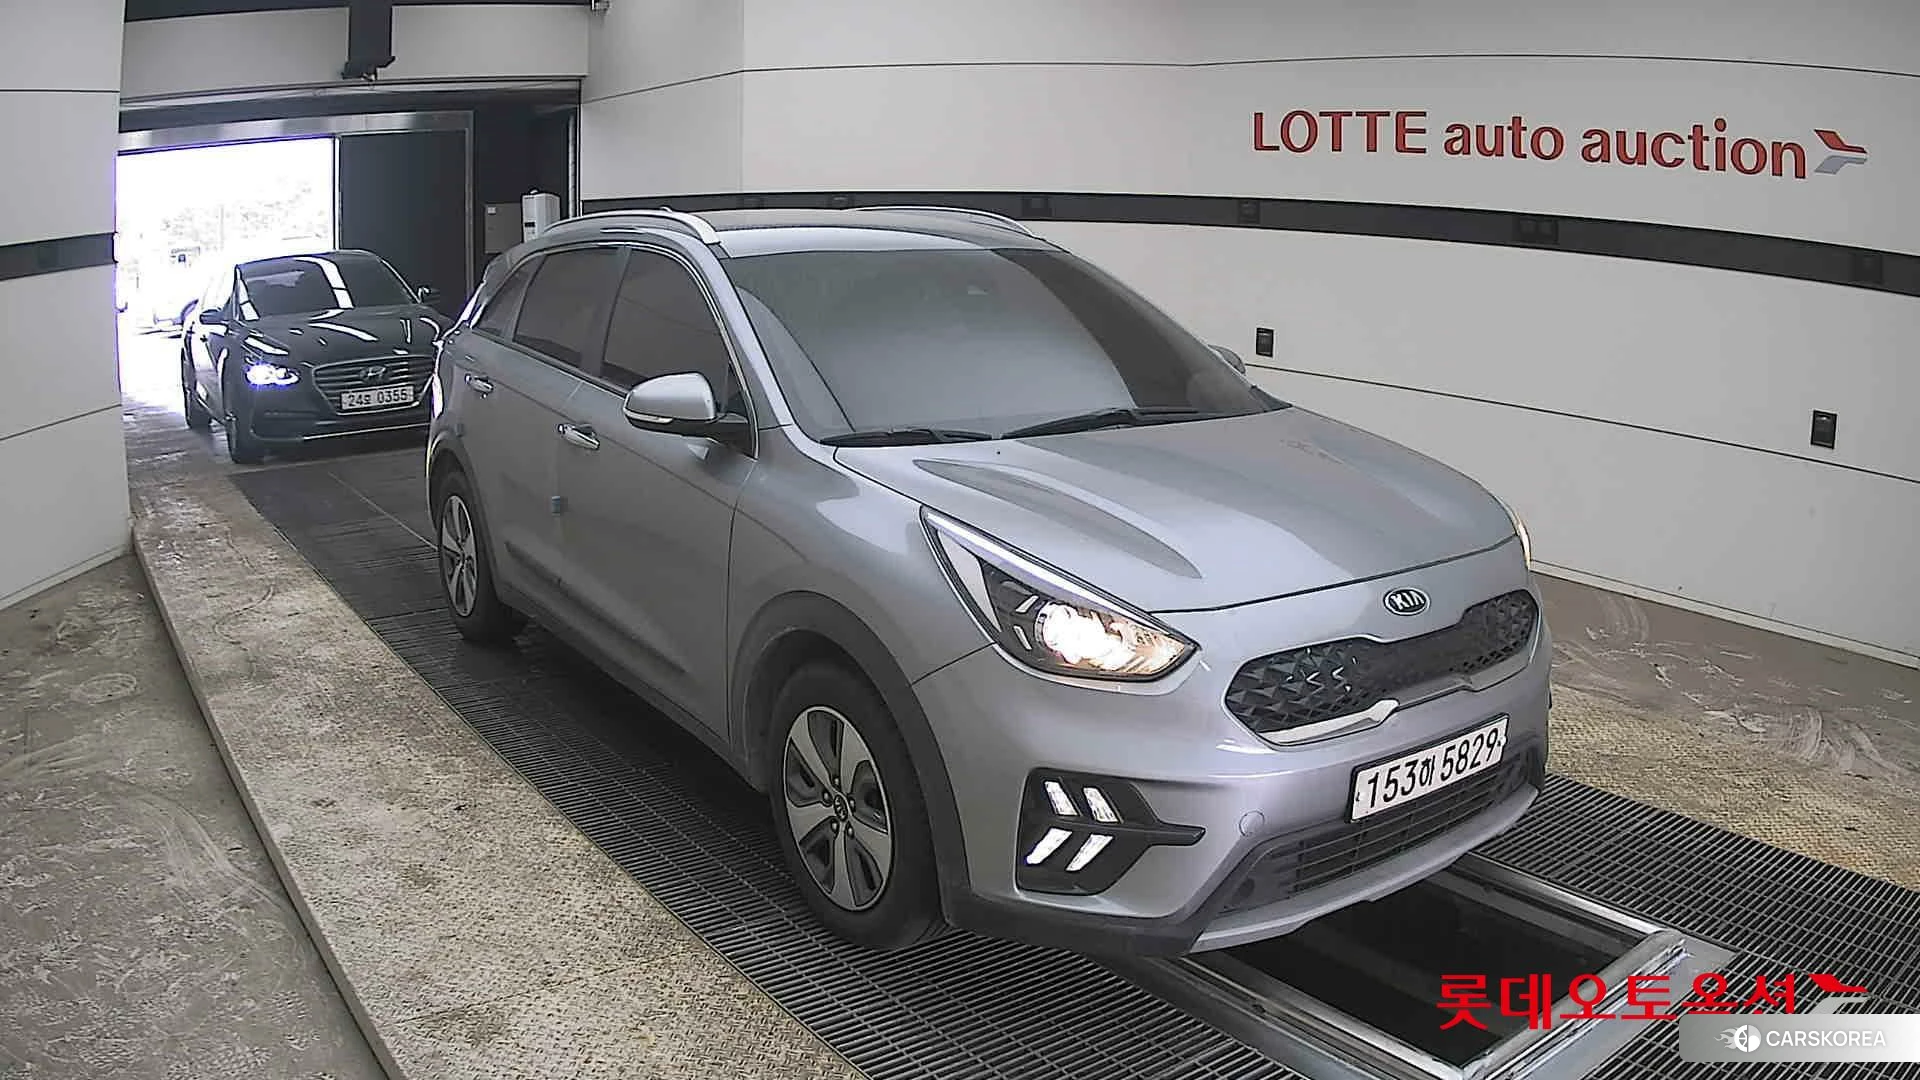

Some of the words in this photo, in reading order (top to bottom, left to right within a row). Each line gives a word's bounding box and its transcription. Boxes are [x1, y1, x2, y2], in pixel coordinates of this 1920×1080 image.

[1253, 111, 1427, 154] LOTTE
[1444, 116, 1564, 160] auto
[1583, 119, 1807, 179] auction
[1390, 590, 1424, 610] KIA
[1440, 727, 1498, 781] 5829
